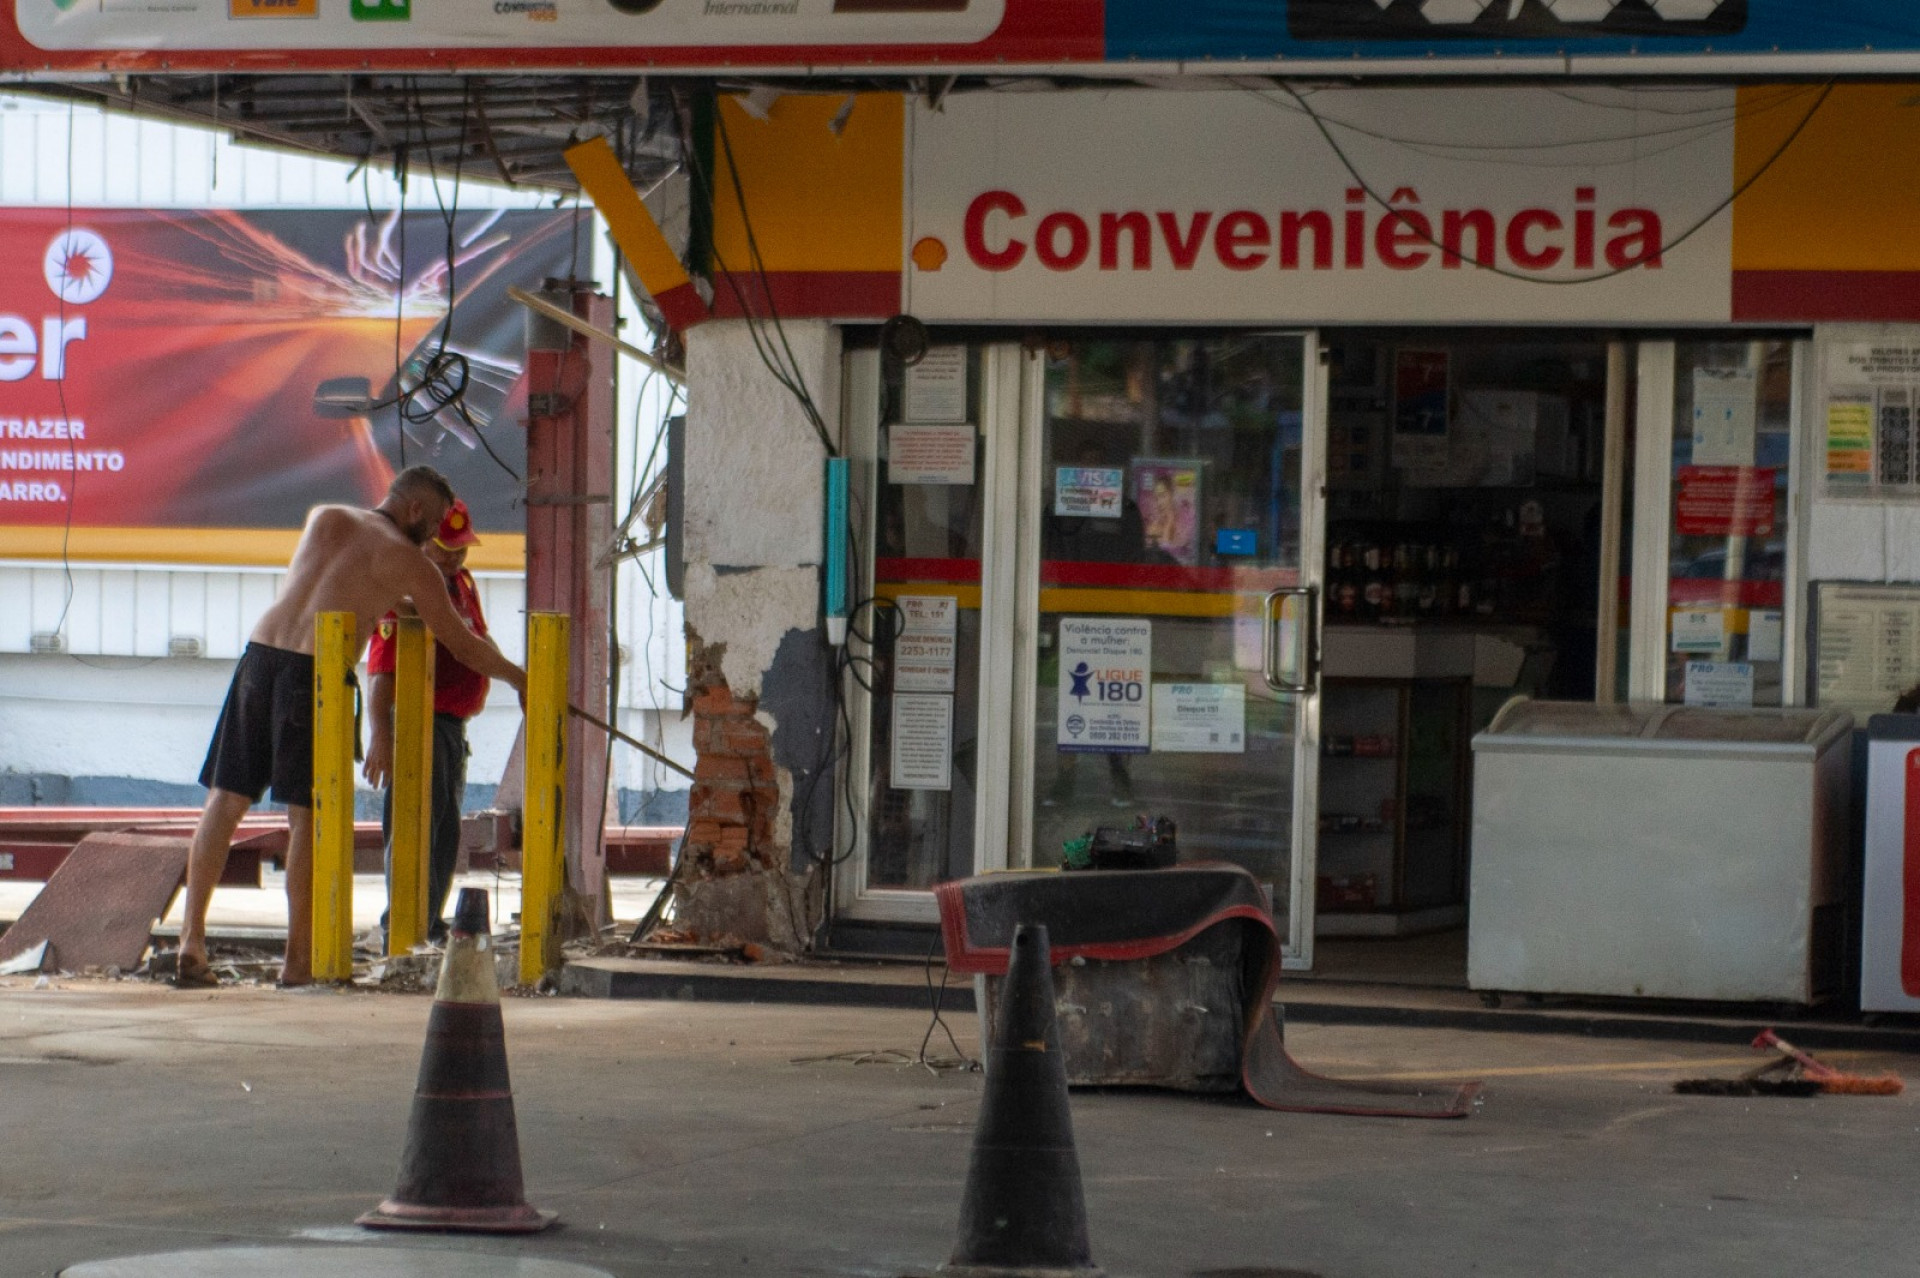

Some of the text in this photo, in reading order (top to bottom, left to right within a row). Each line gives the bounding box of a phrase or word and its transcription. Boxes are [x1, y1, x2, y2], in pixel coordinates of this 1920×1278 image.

[704, 0, 799, 15] International
[963, 187, 1662, 271] Conveniência
[1065, 624, 1147, 636] Violência contra
[900, 646, 953, 657] 2253-1177
[1096, 669, 1144, 681] LIGUE
[1097, 682, 1143, 702] 180
